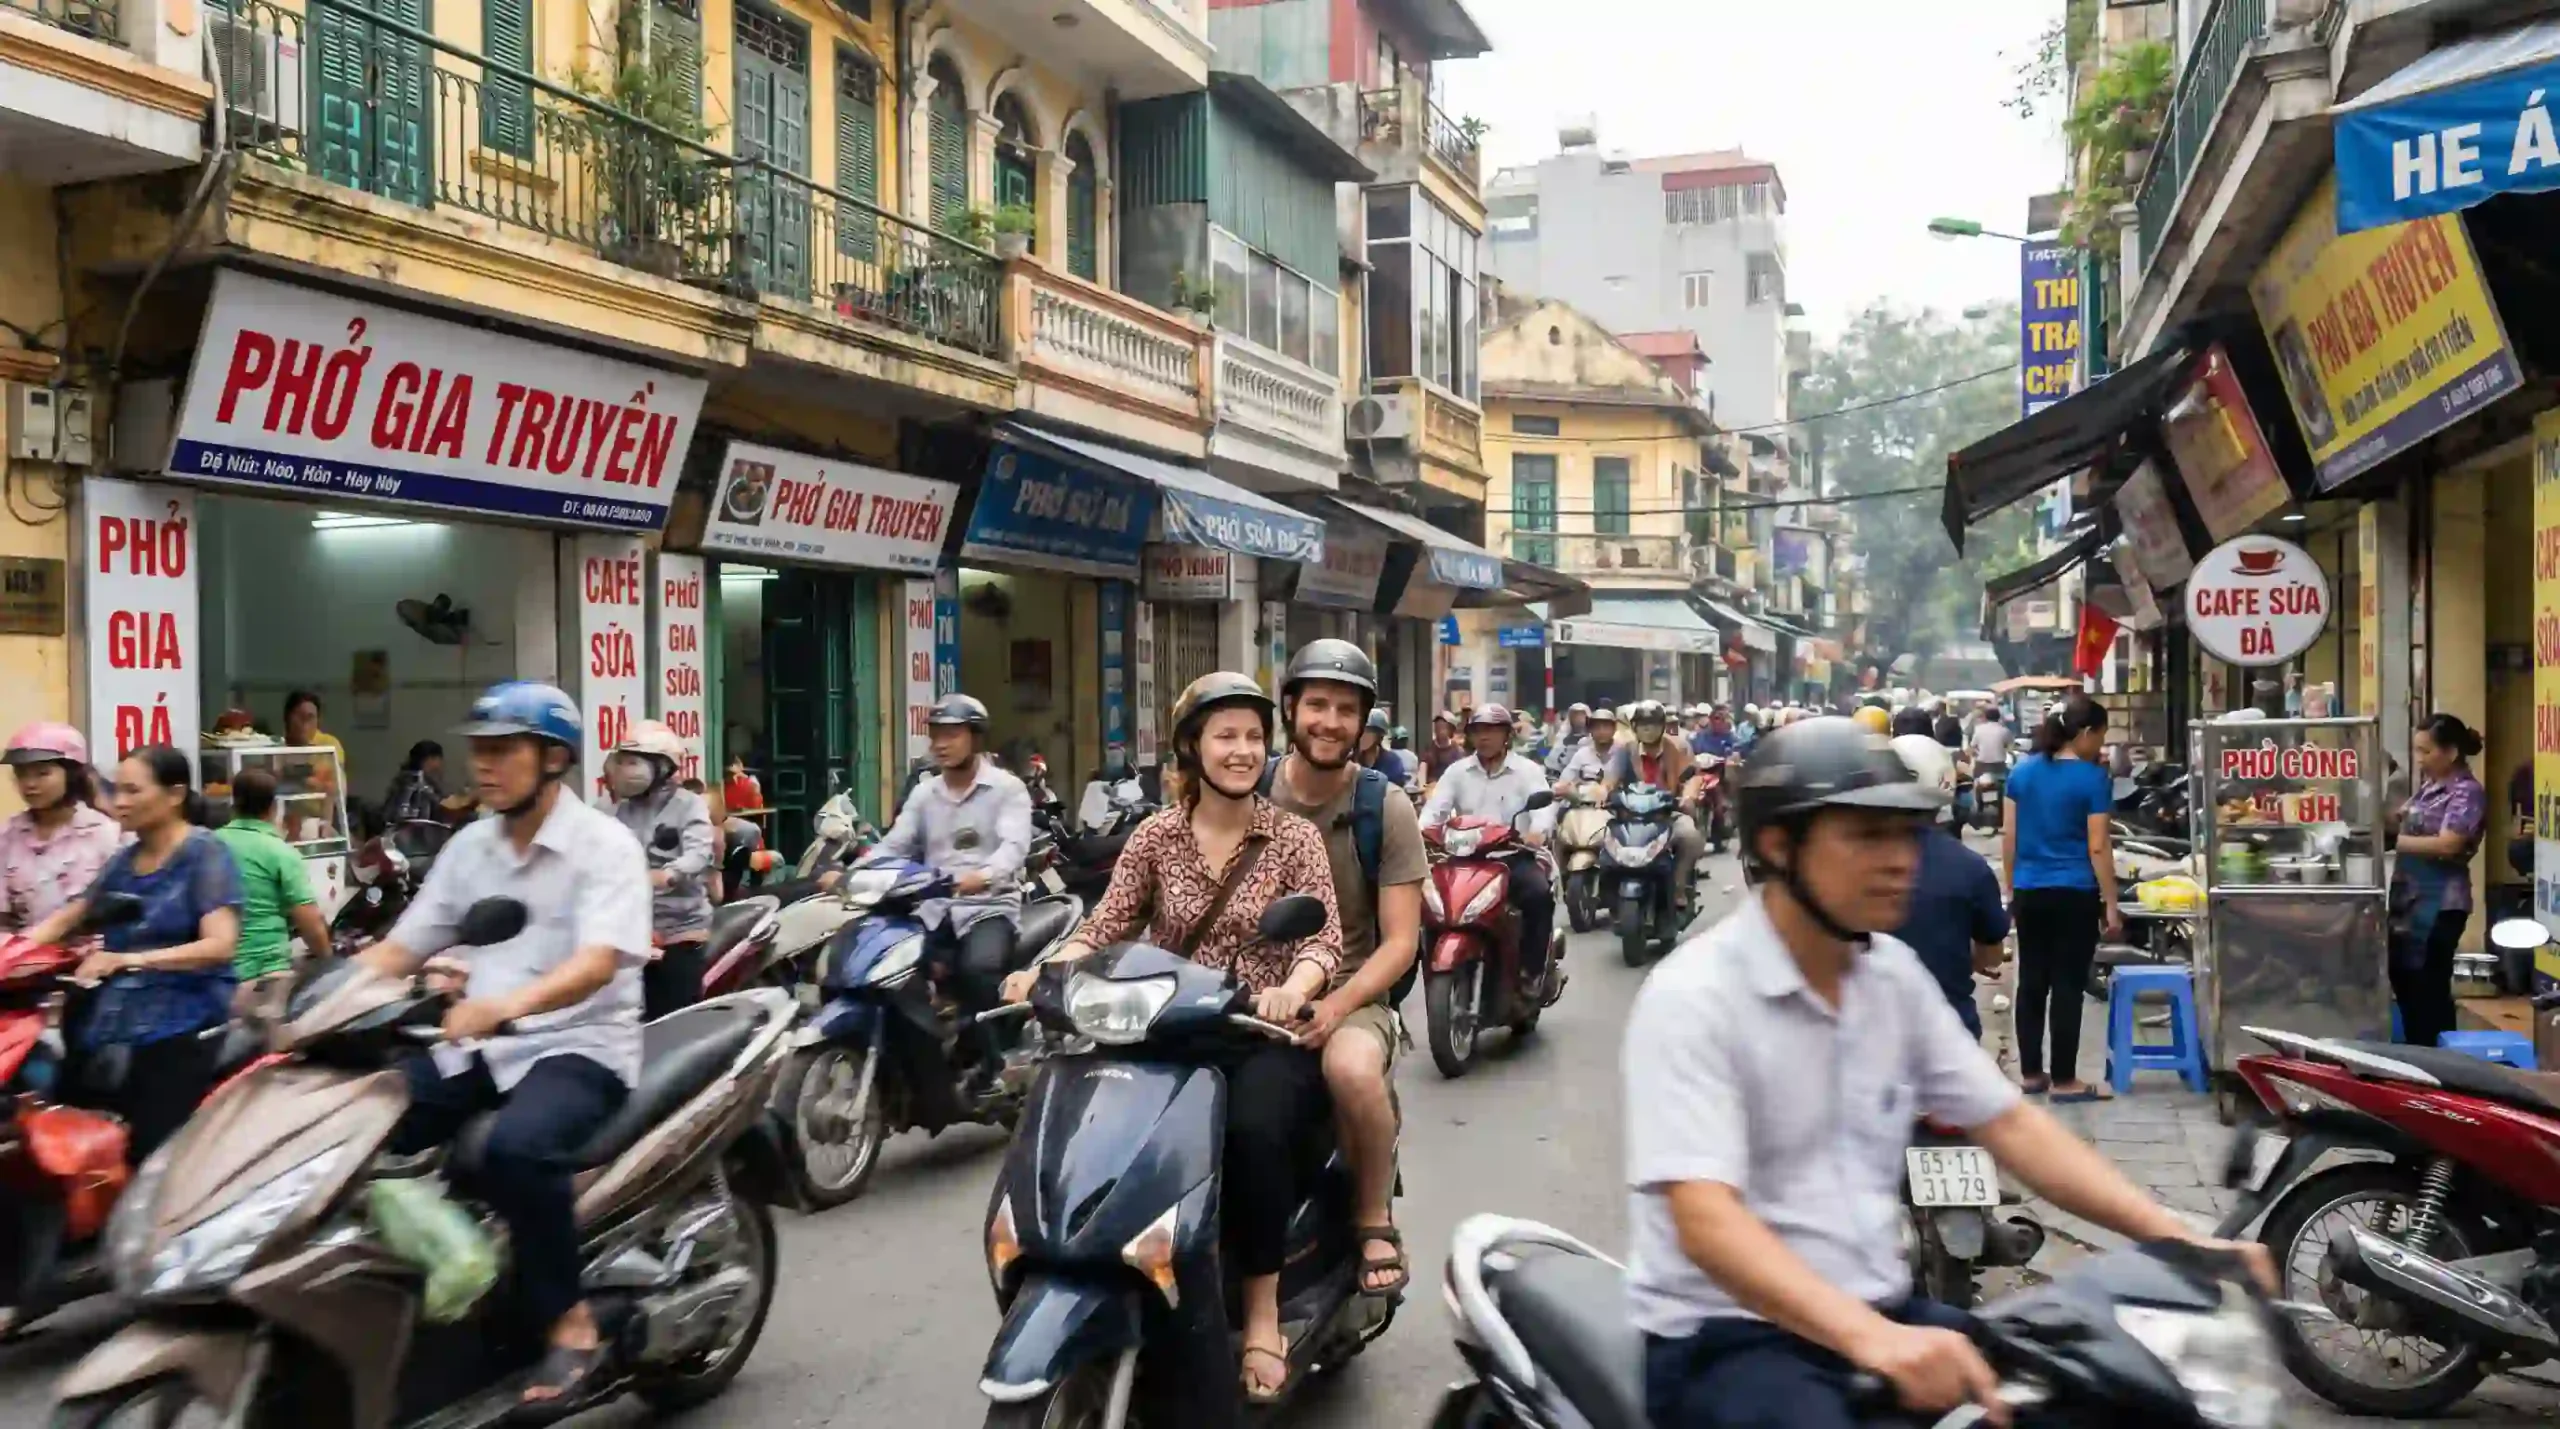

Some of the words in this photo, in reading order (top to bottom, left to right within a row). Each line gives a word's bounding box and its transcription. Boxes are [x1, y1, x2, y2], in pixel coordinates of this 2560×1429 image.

[2393, 122, 2484, 201] HE
[216, 318, 372, 441] PHỞ
[370, 361, 474, 459] GIA
[770, 469, 827, 526] PHỞ
[824, 488, 865, 533] GIA
[99, 500, 188, 578] PHỞ
[585, 550, 640, 606] CAFÉ
[665, 571, 700, 609] PHỞ
[2196, 587, 2260, 616] CAFE
[2269, 580, 2322, 616] SỮA
[108, 610, 182, 670] GIA
[591, 622, 636, 678] SỮA
[669, 624, 698, 652] GIA
[666, 662, 701, 697] SỮA
[912, 651, 931, 682] GIA
[115, 691, 173, 762] ĐÁ
[2221, 738, 2278, 779] PHỞ
